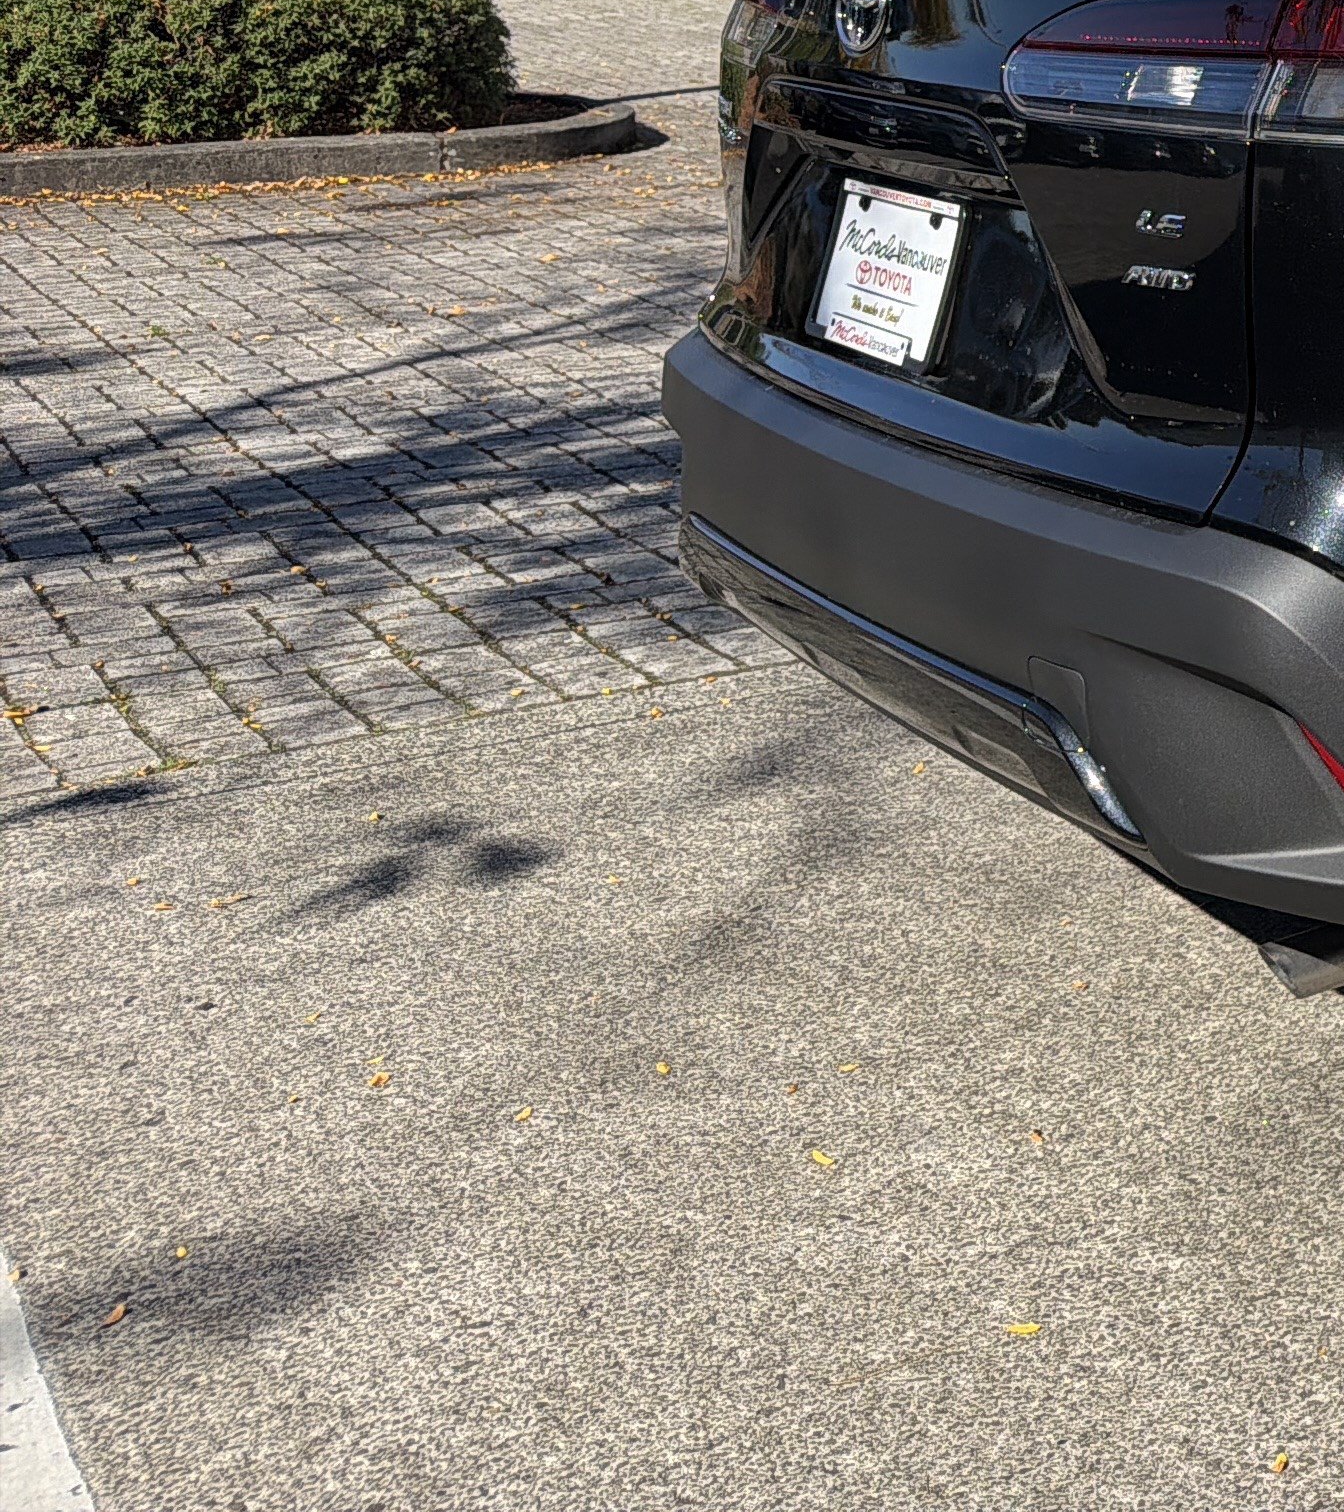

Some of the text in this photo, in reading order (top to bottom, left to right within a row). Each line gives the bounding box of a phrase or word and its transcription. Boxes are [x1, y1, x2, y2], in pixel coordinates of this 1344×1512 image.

[1135, 210, 1186, 240] LE
[872, 265, 913, 296] TOYOTA
[1120, 265, 1197, 291] AWD
